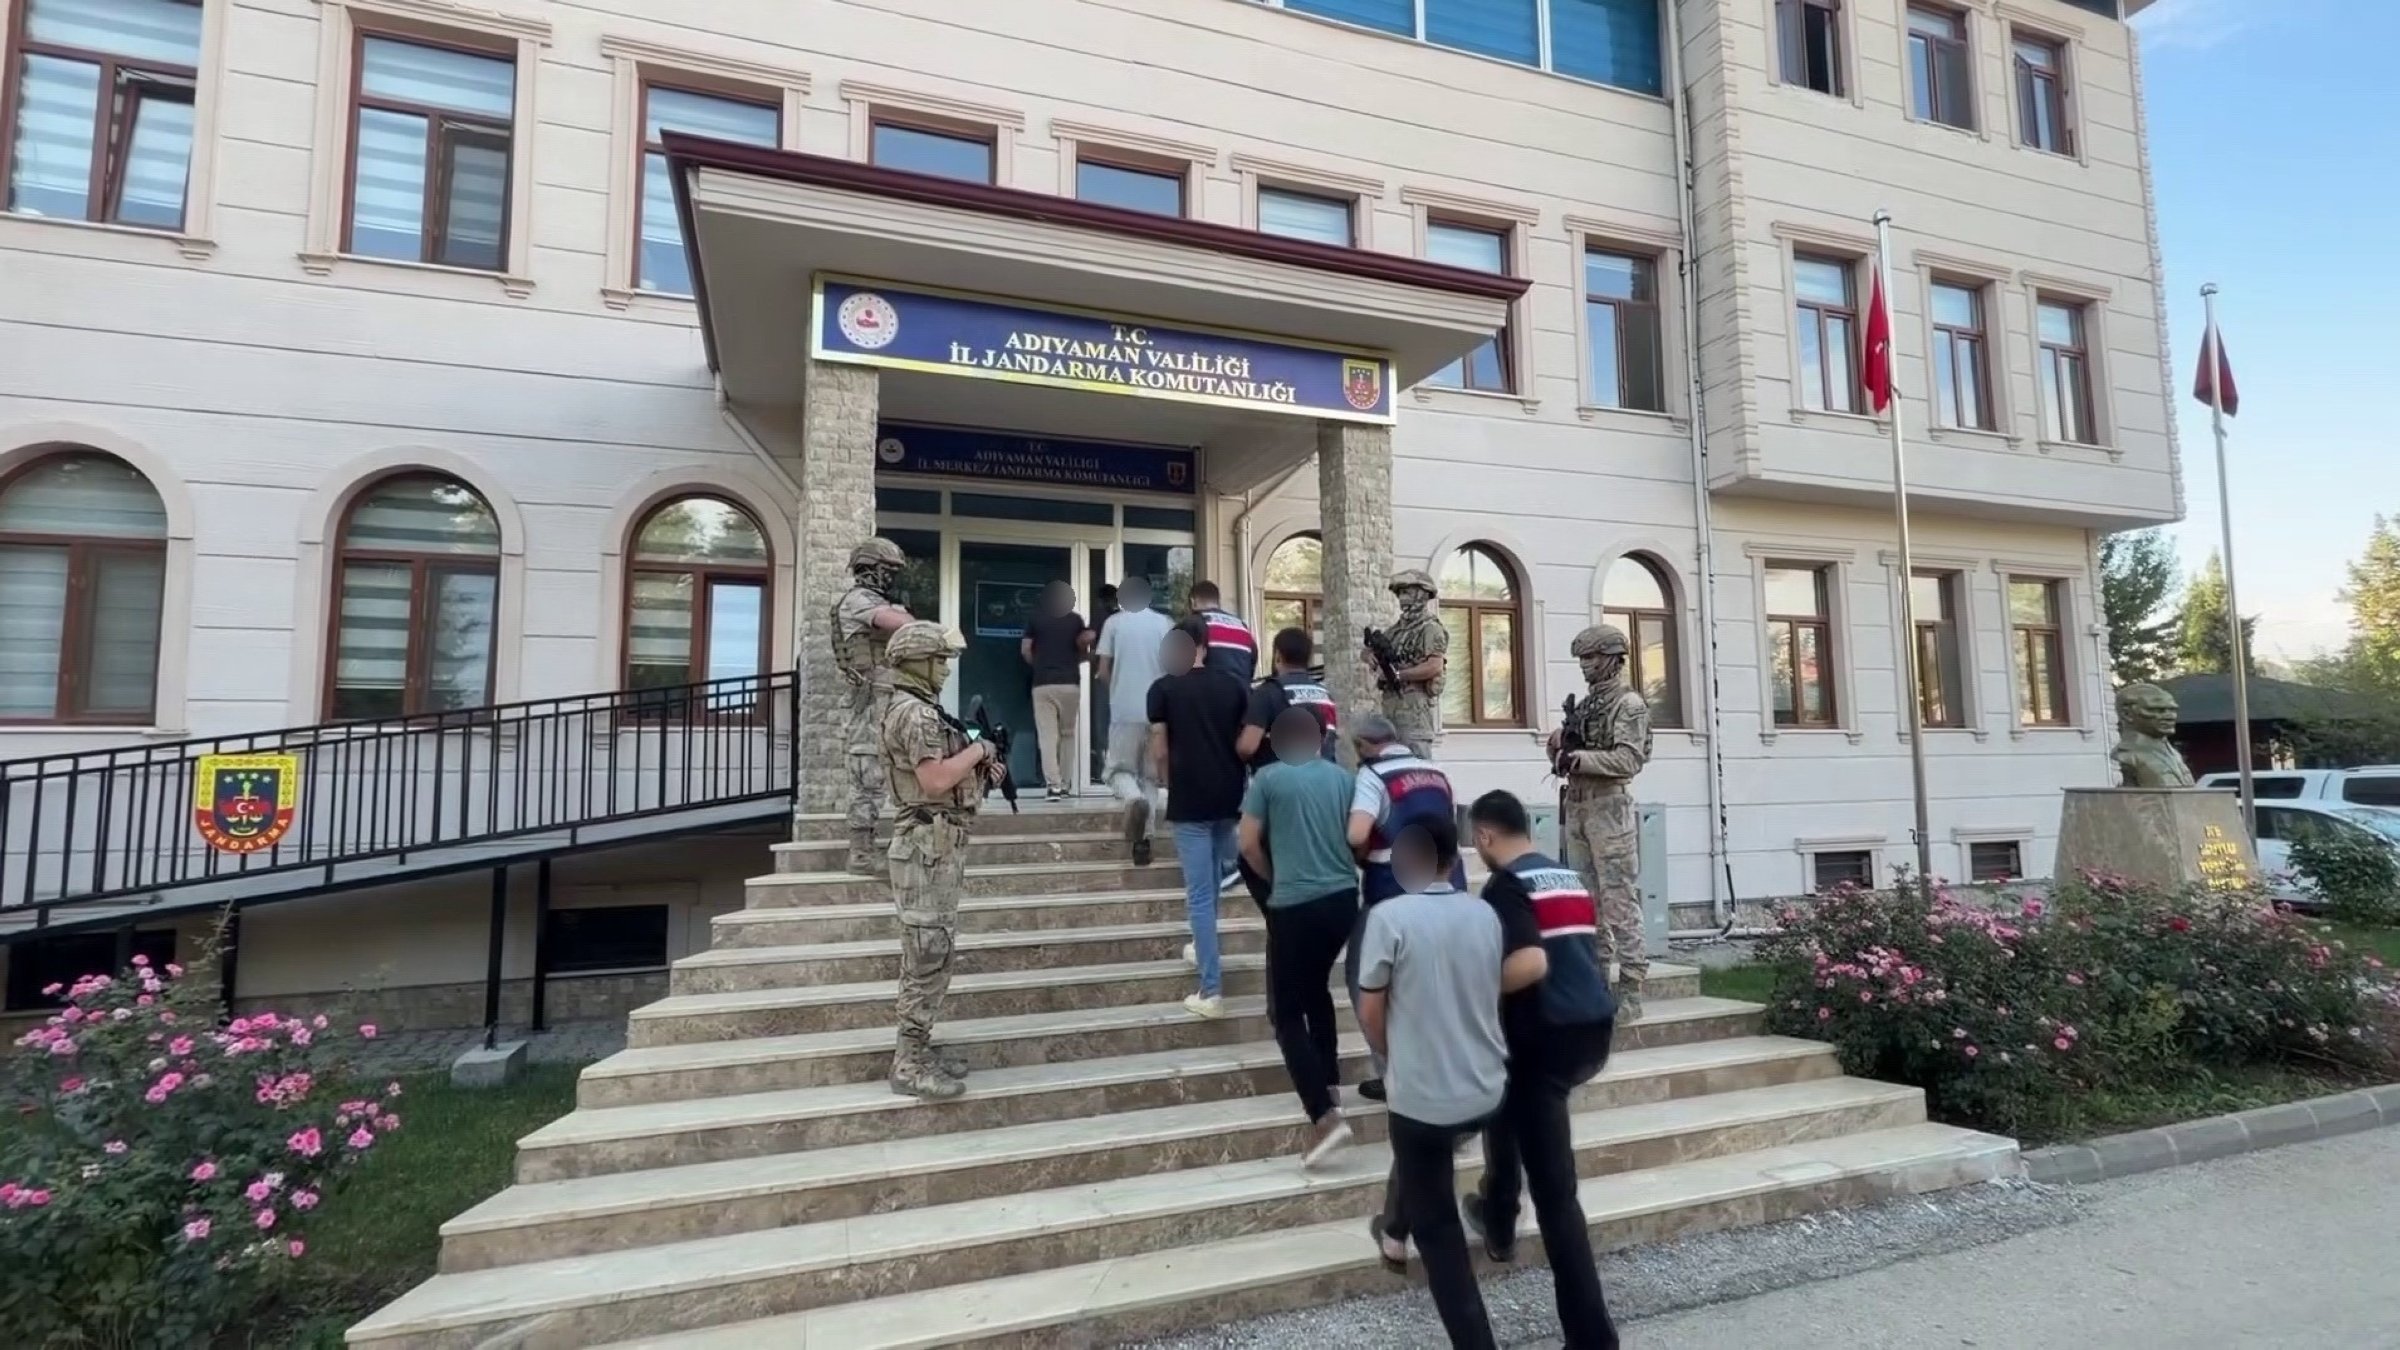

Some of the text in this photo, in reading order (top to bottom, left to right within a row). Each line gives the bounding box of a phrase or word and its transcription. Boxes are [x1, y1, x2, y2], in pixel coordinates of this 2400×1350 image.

[1004, 331, 1251, 379] ADIYAMAN VALİLİĞİ
[1110, 324, 1154, 346] T.C.
[949, 341, 1297, 404] İL JANDARMA KOMUTANLIĞI
[200, 818, 289, 850] JANDARMA
